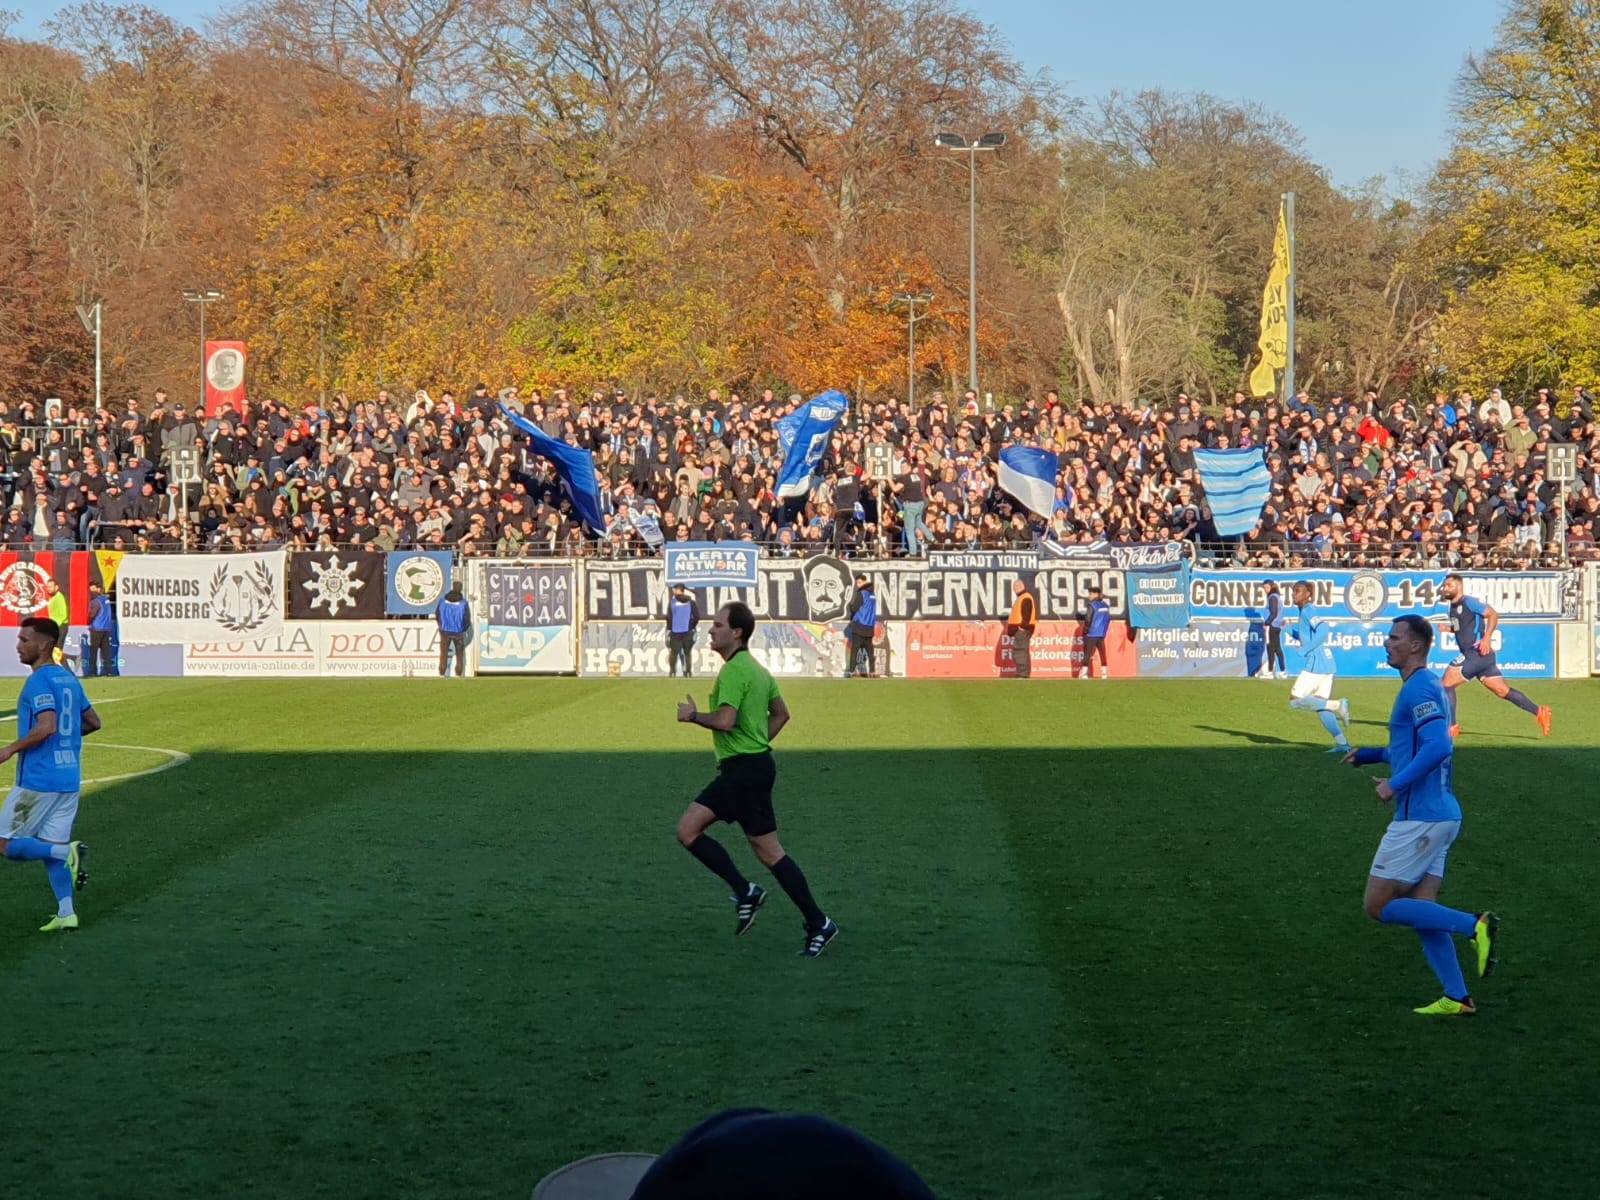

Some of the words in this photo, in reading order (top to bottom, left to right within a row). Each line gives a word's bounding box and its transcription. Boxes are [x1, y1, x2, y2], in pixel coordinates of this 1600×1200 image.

[675, 551, 747, 561] ALERTA
[929, 555, 993, 567] FILMSTADT
[997, 555, 1038, 568] YOUTH
[675, 560, 747, 571] NETWORK
[122, 577, 200, 597] SKINHEADS
[864, 571, 1018, 616] NFERNO
[1034, 570, 1126, 616] 1999
[1191, 579, 1333, 607] CONNETN
[122, 602, 210, 619] BABELSBERG
[480, 629, 546, 659] SAP
[1001, 634, 1016, 646] Da
[1140, 628, 1199, 645] Mitglied
[1203, 628, 1263, 642] werden.
[1325, 632, 1362, 650] Liga
[1001, 648, 1085, 661] Finzkonzep
[1141, 648, 1179, 659] ...Yalla,
[1183, 648, 1208, 658] Yalla
[1211, 648, 1237, 658] SVB!
[186, 661, 315, 672] www.provia-online.de
[326, 660, 437, 672] www.provia-online
[58, 687, 73, 736] 8
